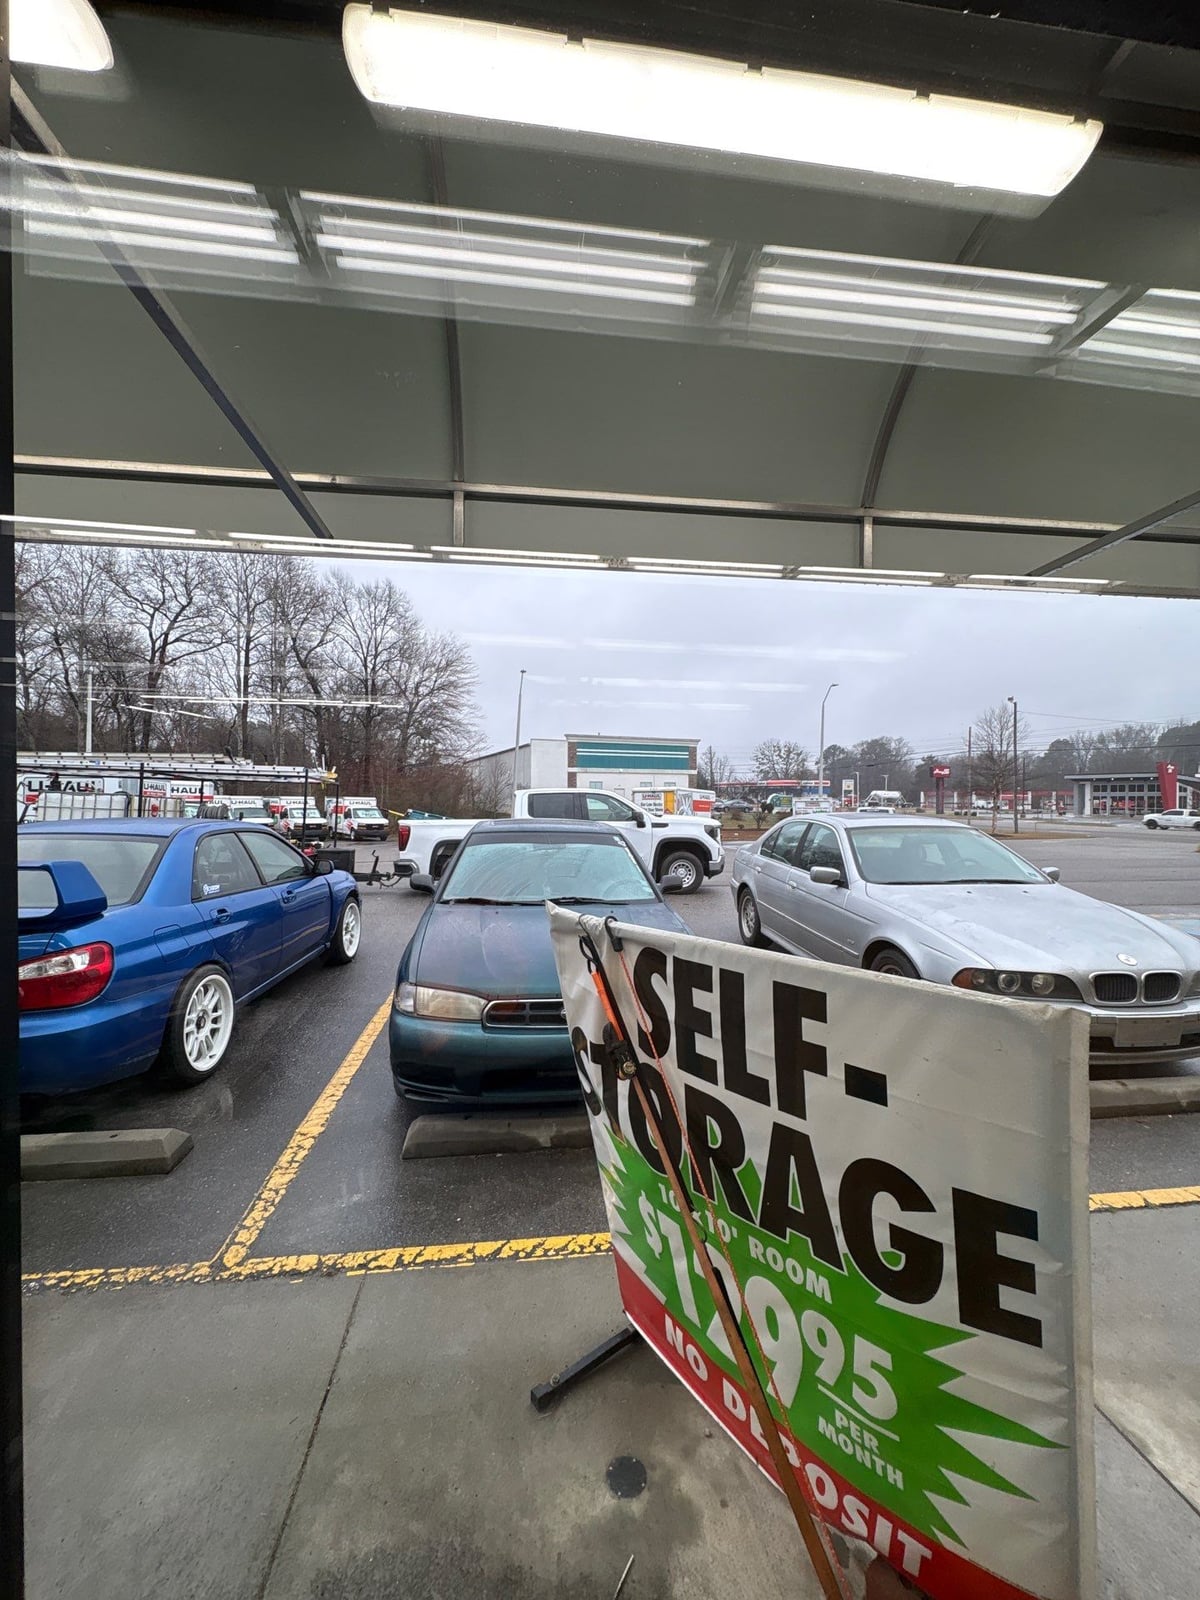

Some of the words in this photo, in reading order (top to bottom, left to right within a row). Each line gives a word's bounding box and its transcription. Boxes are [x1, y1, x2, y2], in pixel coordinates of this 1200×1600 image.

[144, 783, 167, 791] U-HAUL
[633, 947, 888, 1120] SELF-
[572, 1026, 1043, 1349] STORAGE
[748, 1235, 833, 1304] ROOM
[664, 1313, 709, 1382] NO
[817, 1415, 905, 1491] MONTH
[834, 1408, 880, 1454] PER
